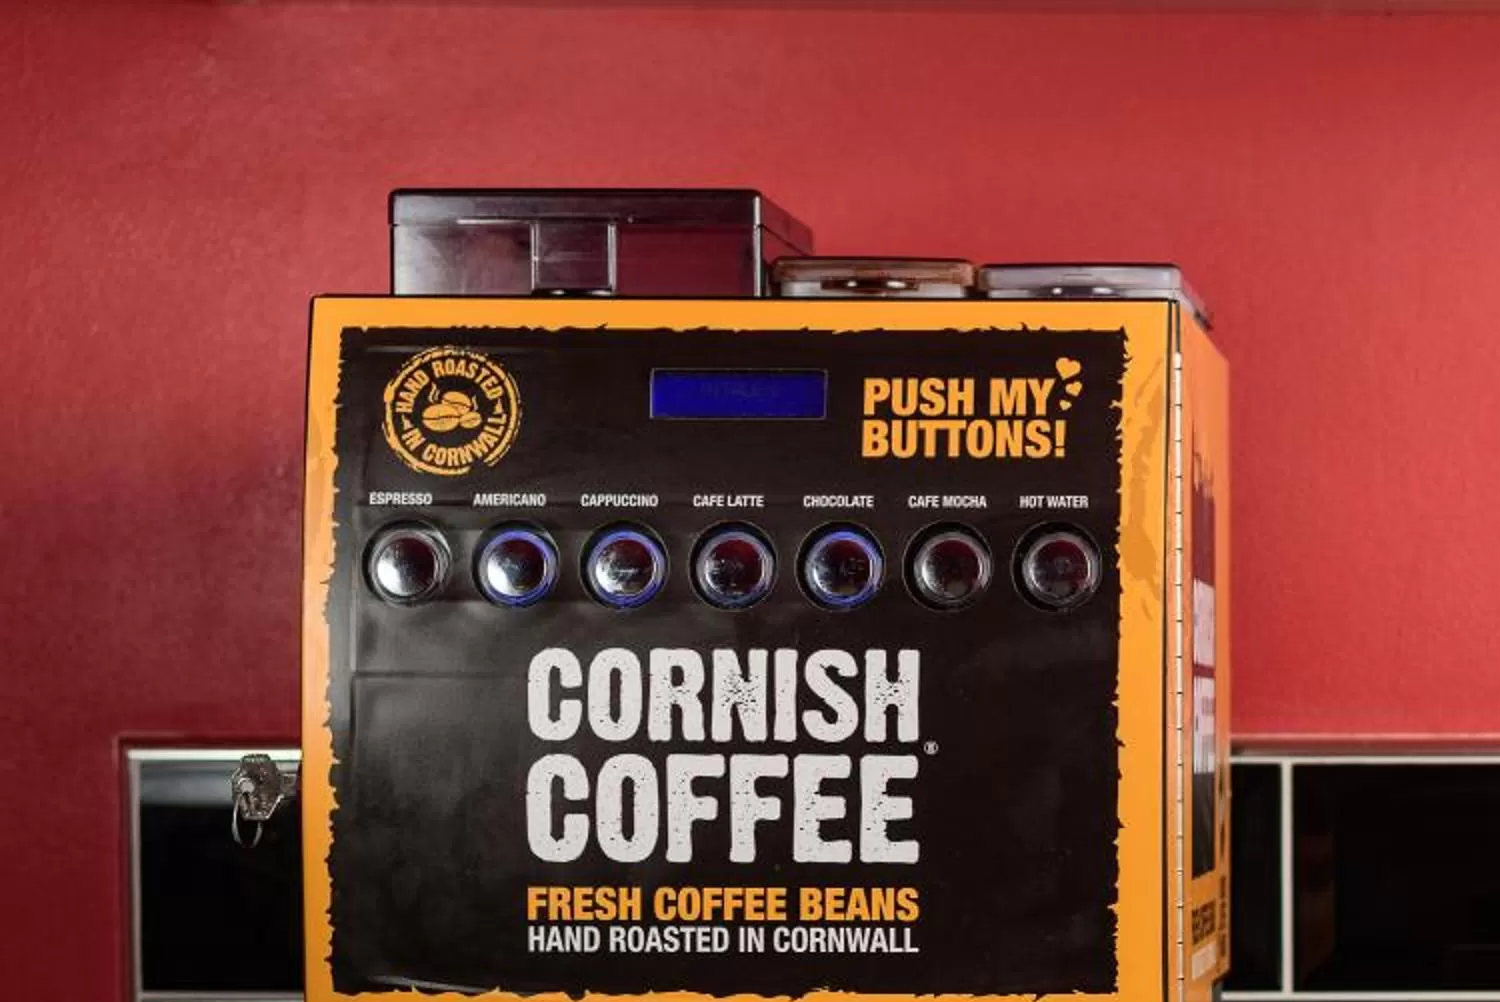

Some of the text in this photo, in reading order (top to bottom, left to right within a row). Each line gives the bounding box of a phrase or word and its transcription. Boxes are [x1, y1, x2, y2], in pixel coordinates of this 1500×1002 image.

[395, 359, 504, 413] HAND ROASTED
[863, 377, 1056, 417] PUSH MY
[402, 413, 507, 467] IN CORNWALL
[862, 419, 1065, 459] BUTTONS!
[369, 491, 433, 506] ESPRESSO
[473, 493, 547, 508] AMERICANO
[580, 494, 659, 508] CAPPUCCINO
[693, 494, 765, 508] CAFE LATTE
[803, 495, 875, 509] CHOCOLATE
[908, 495, 987, 509] CAFE MOCHA
[1019, 495, 1089, 509] HOT WATER
[527, 648, 921, 743] CORNISH
[526, 754, 920, 864] COFFEE
[528, 886, 920, 922] FRESH COFFEE BEANS
[528, 926, 919, 953] HAND ROASTED IN CORNWALL
